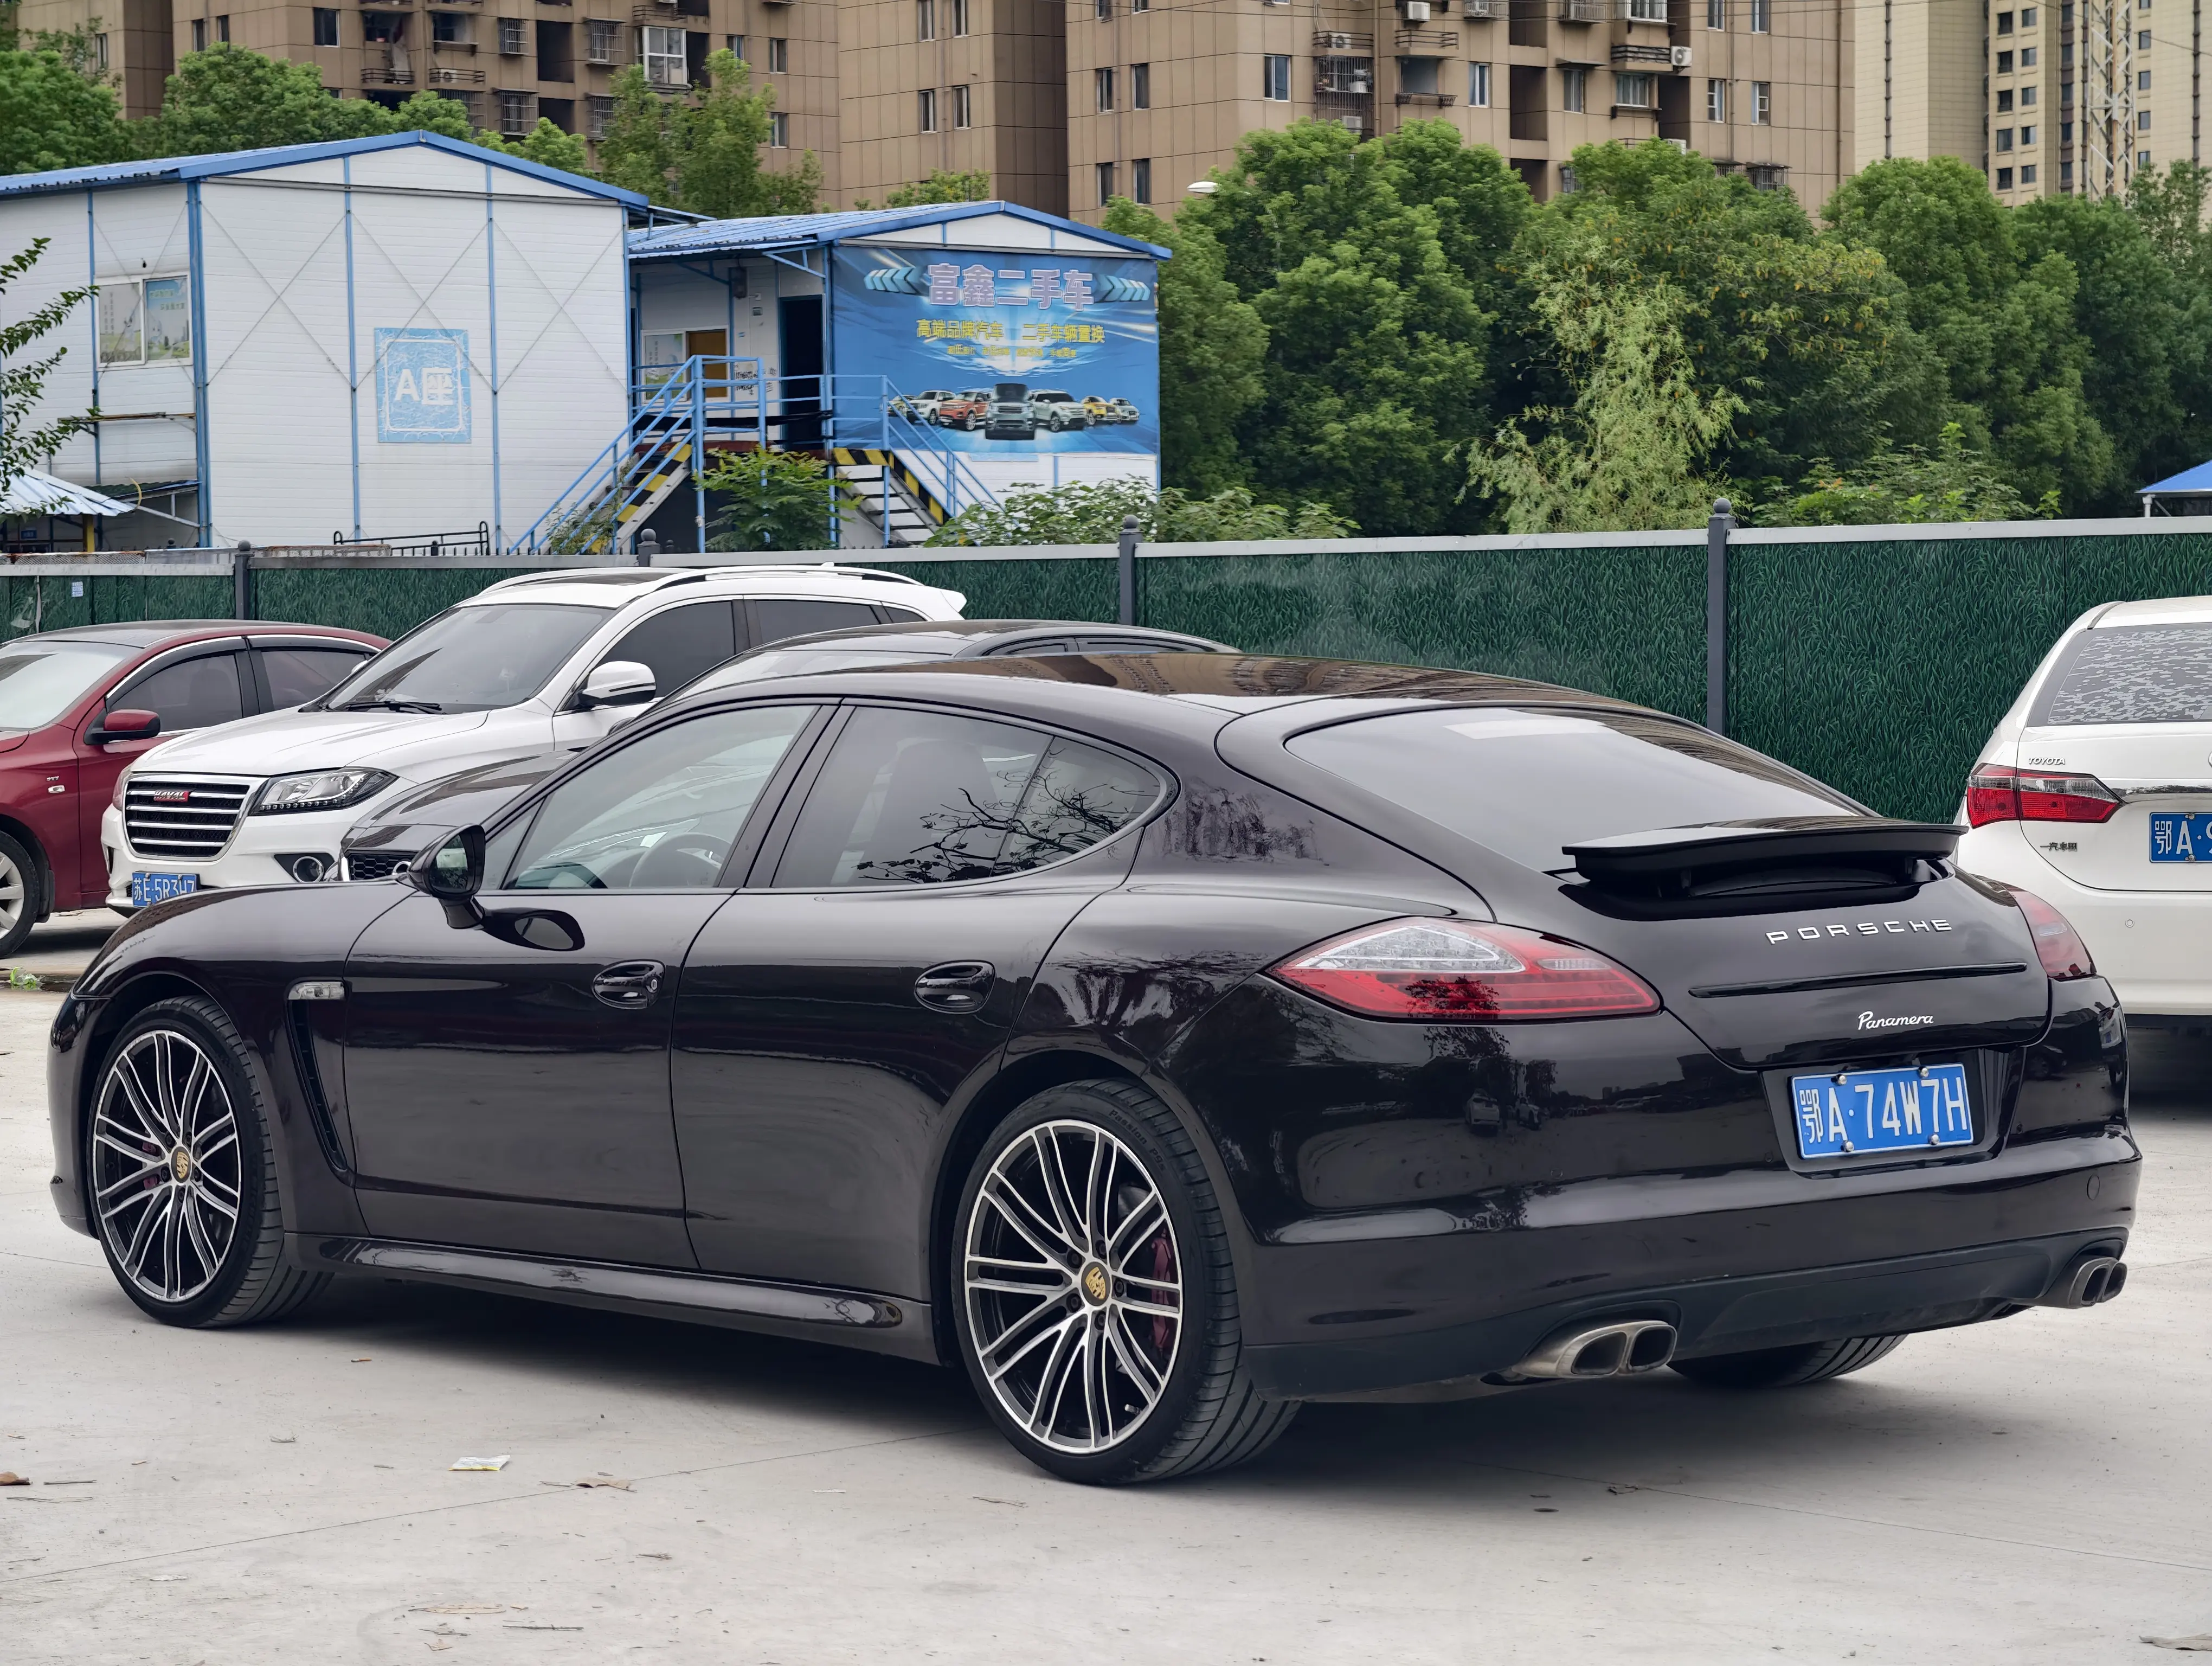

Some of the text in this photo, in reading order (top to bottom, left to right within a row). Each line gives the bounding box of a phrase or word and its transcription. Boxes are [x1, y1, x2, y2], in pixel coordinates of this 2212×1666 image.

[928, 263, 1094, 311] 富鑫二手车
[916, 319, 1105, 343] 高端品牌汽车 二手车辆置换
[395, 367, 453, 405] A座
[2029, 757, 2065, 765] TOYOTA
[1766, 919, 1952, 945] PORSCHE
[1857, 1010, 1934, 1030] Panamera
[1109, 1109, 1147, 1145] Passion
